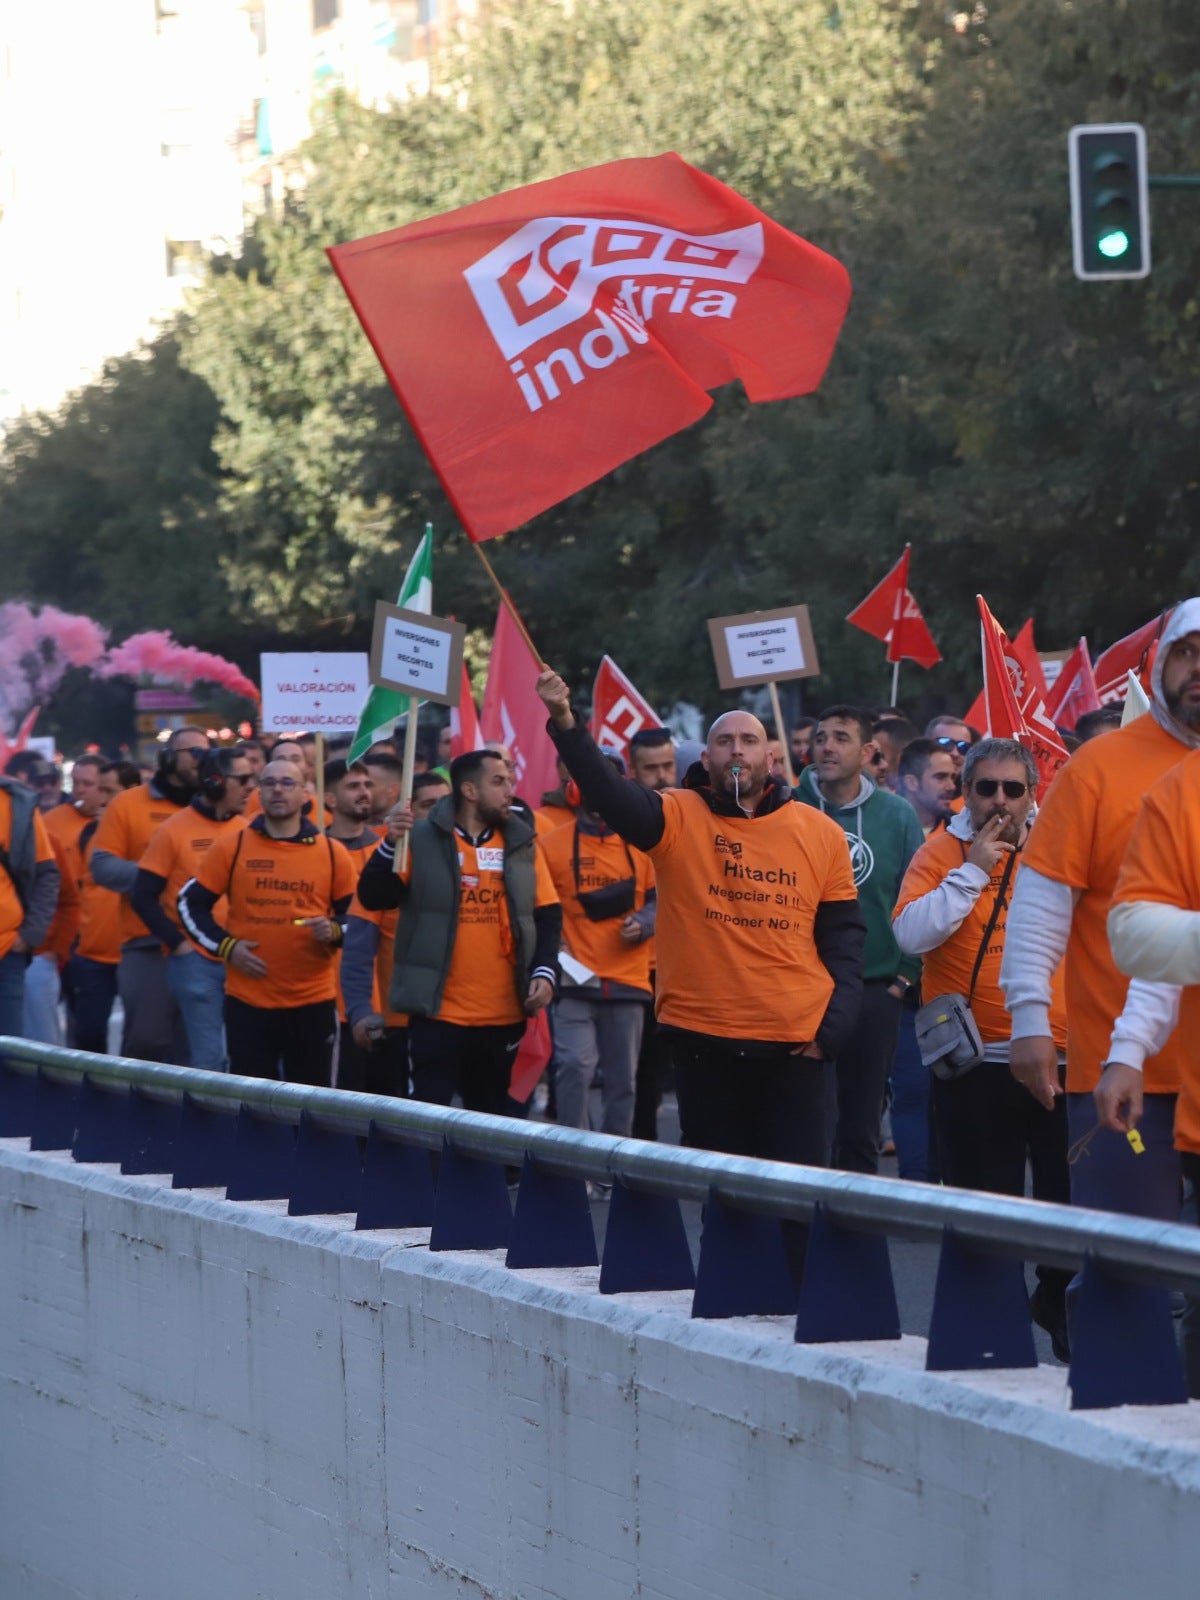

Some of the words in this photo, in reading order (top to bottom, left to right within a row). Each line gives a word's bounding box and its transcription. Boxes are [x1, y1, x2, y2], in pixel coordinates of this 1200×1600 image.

[394, 628, 440, 647] INVERSIONES
[397, 653, 434, 669] RECORTES
[272, 715, 358, 726] COMUNICACIO
[724, 860, 798, 887] Hitachi
[255, 877, 316, 893] Hitachi
[708, 884, 771, 902] Negociar
[775, 893, 788, 906] SI
[705, 908, 764, 928] Imponer
[768, 917, 790, 930] NO
